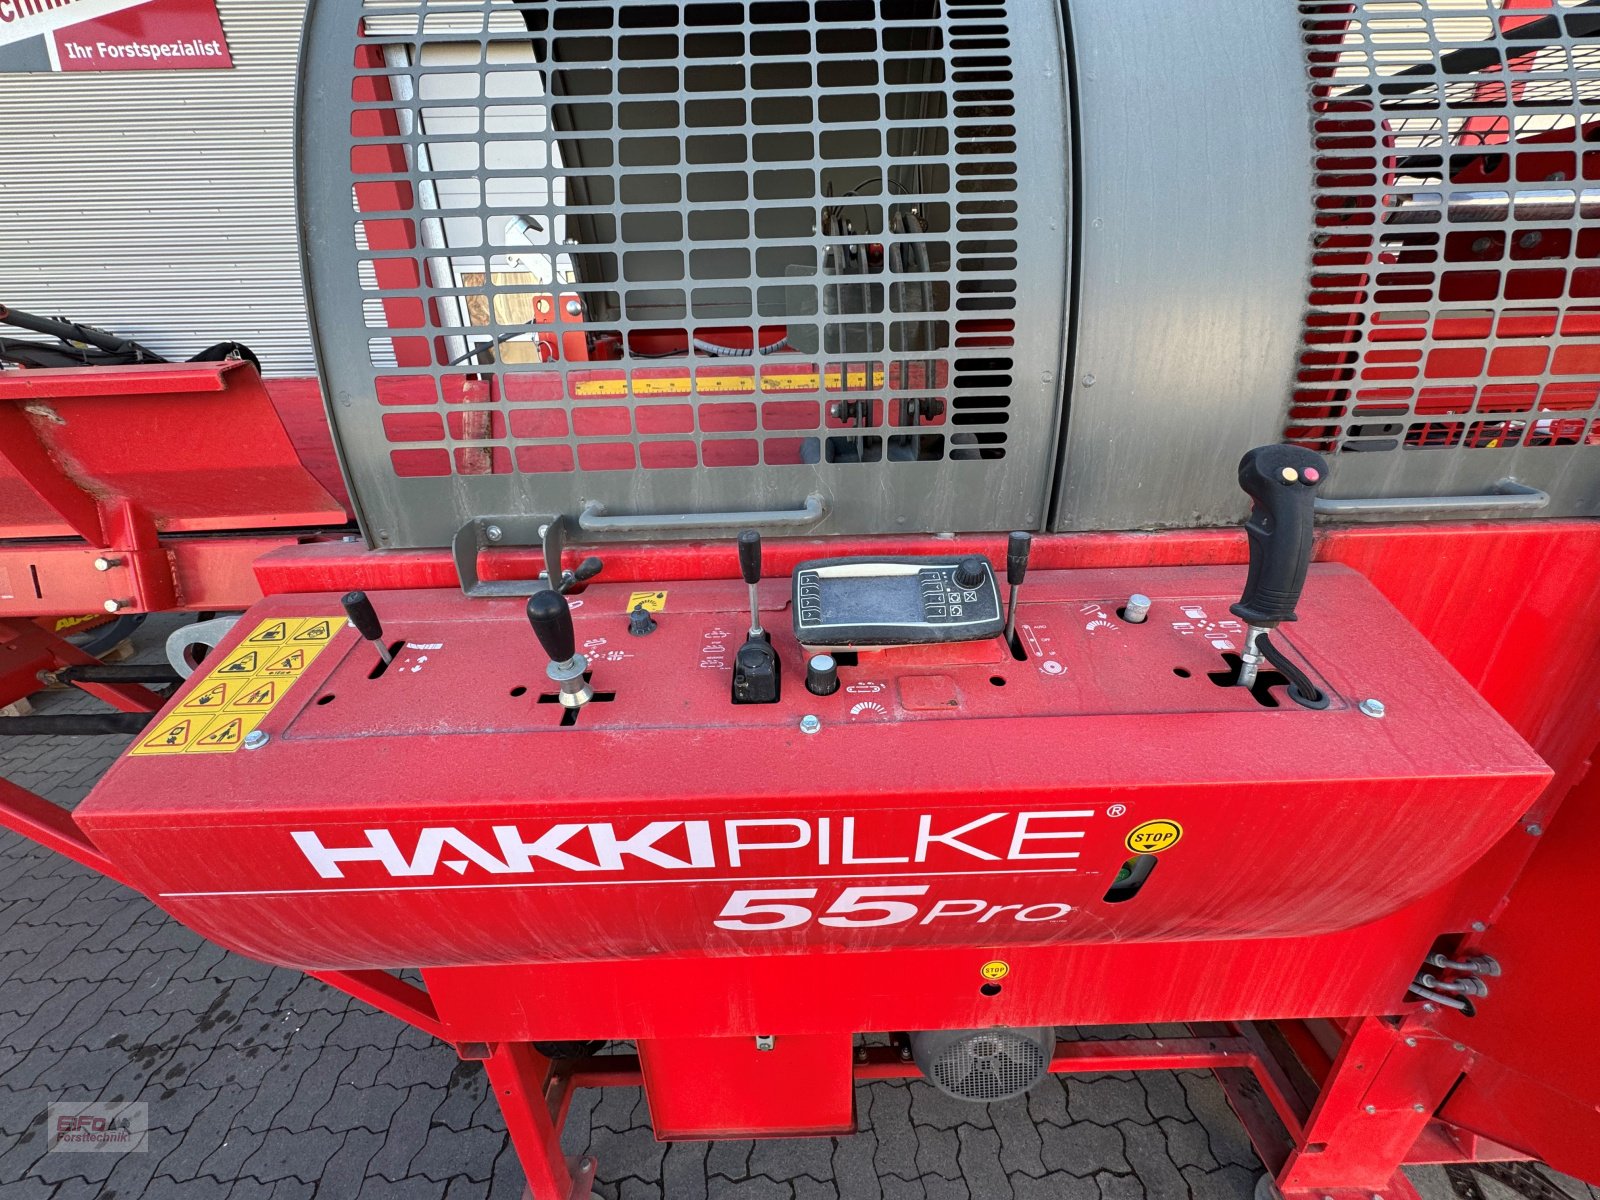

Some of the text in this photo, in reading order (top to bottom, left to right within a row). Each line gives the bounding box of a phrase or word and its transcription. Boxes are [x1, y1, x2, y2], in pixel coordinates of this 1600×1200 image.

[64, 39, 223, 61] Ihr Forstspezialist
[1134, 832, 1174, 843] STOP
